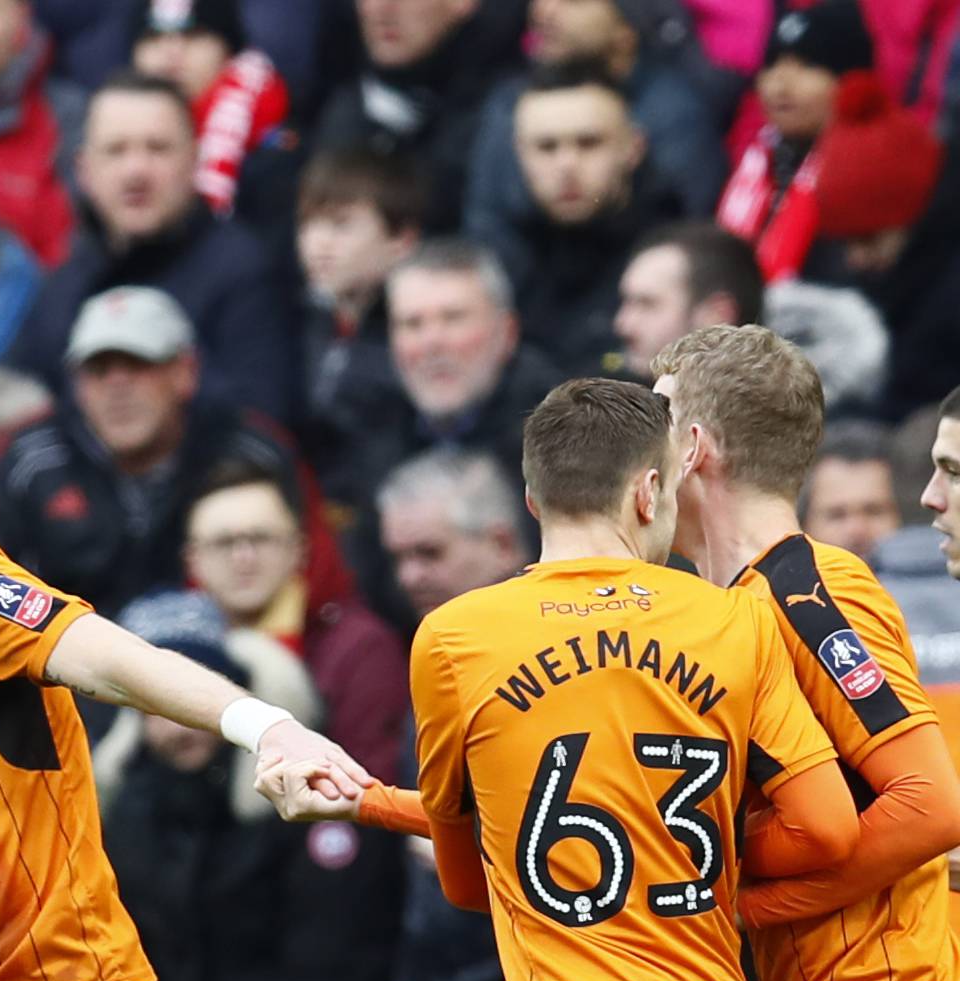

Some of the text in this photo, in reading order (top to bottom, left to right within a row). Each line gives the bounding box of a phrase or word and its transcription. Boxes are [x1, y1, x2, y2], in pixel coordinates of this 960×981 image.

[540, 598, 652, 617] Paycare
[495, 629, 728, 717] WEIMANN
[515, 731, 729, 928] 63
